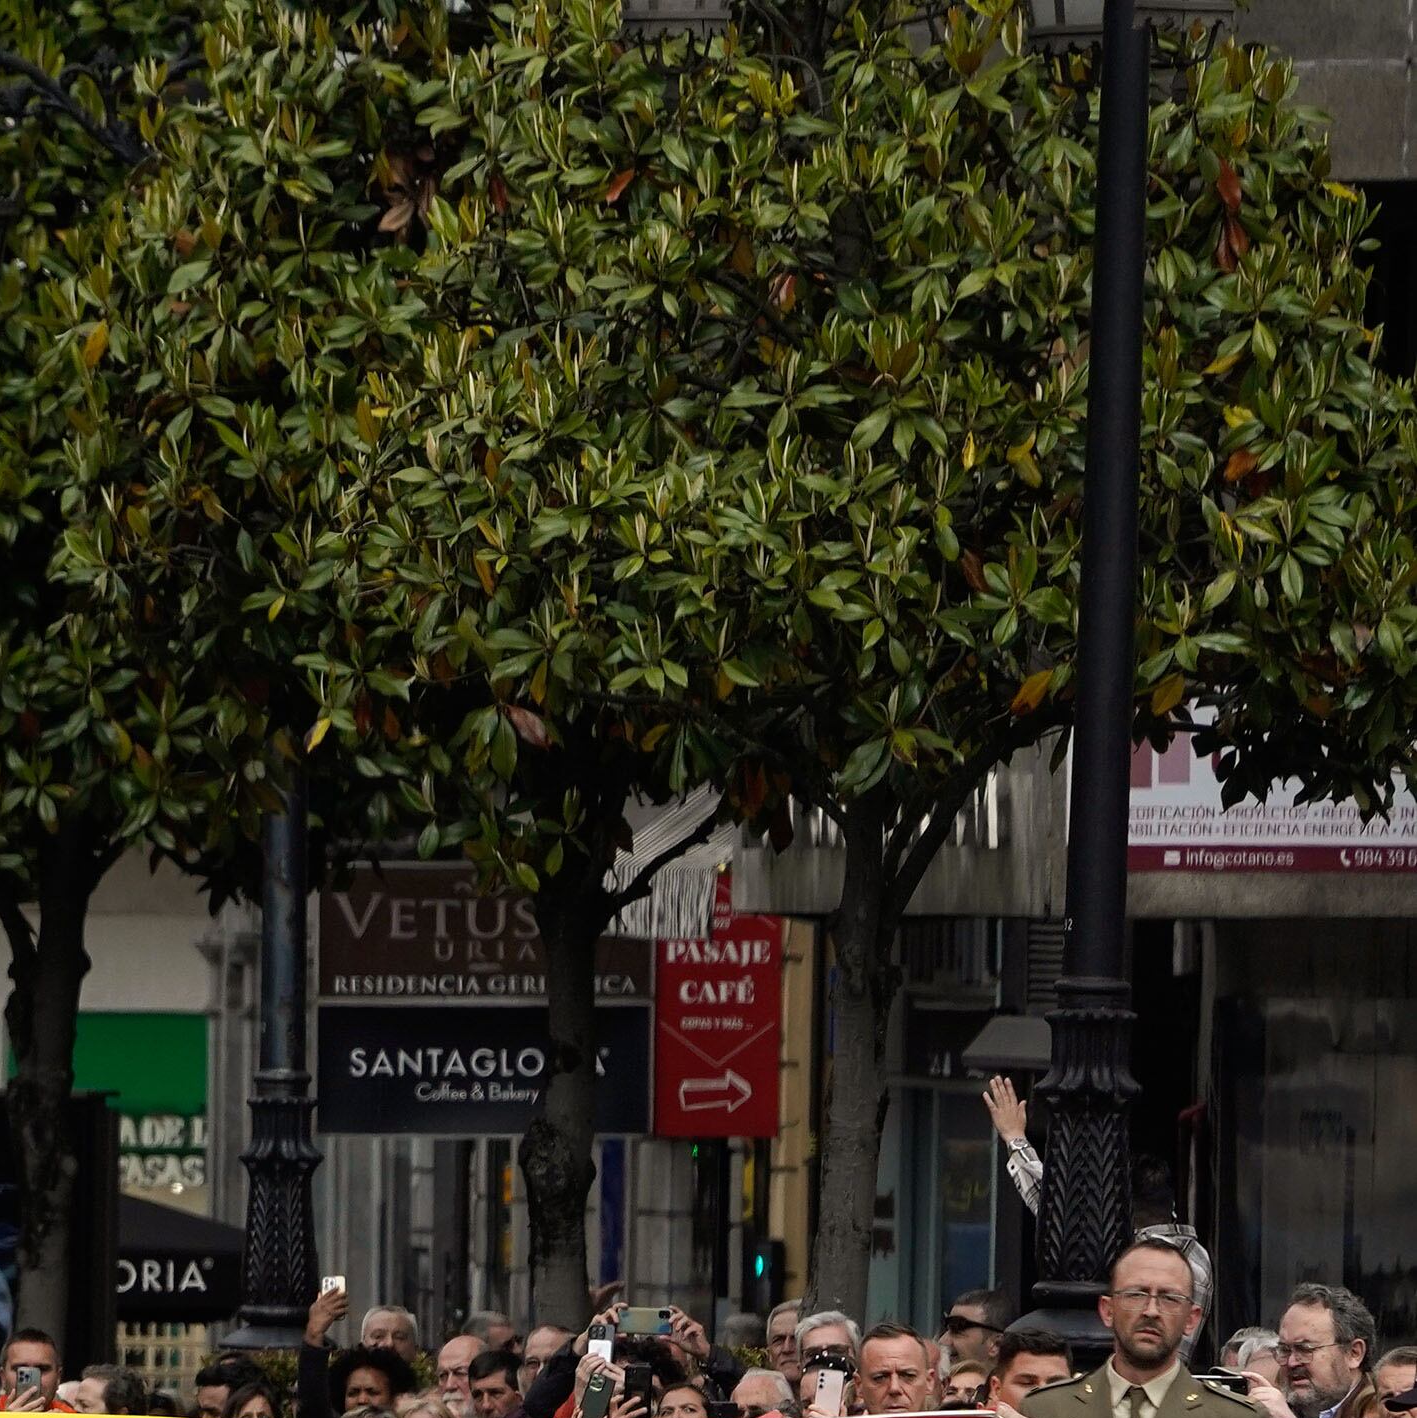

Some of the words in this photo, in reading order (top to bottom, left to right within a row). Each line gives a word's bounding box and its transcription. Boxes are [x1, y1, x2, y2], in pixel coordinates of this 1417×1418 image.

[1322, 806, 1396, 820] REFOS
[1128, 821, 1212, 836] ABILITACIÓN
[1224, 822, 1300, 837] EFICIENCIA
[334, 891, 540, 940] VETUS
[666, 939, 771, 967] PASAJE
[334, 974, 480, 995] RESIDENCIA
[487, 974, 636, 995] GERIICA
[679, 974, 755, 1004] CAFÉ
[349, 1047, 605, 1078] SANTAGLO
[416, 1082, 467, 1100] Coffee
[470, 1083, 484, 1100] &
[488, 1082, 540, 1104] Bakery
[119, 1115, 138, 1148] A
